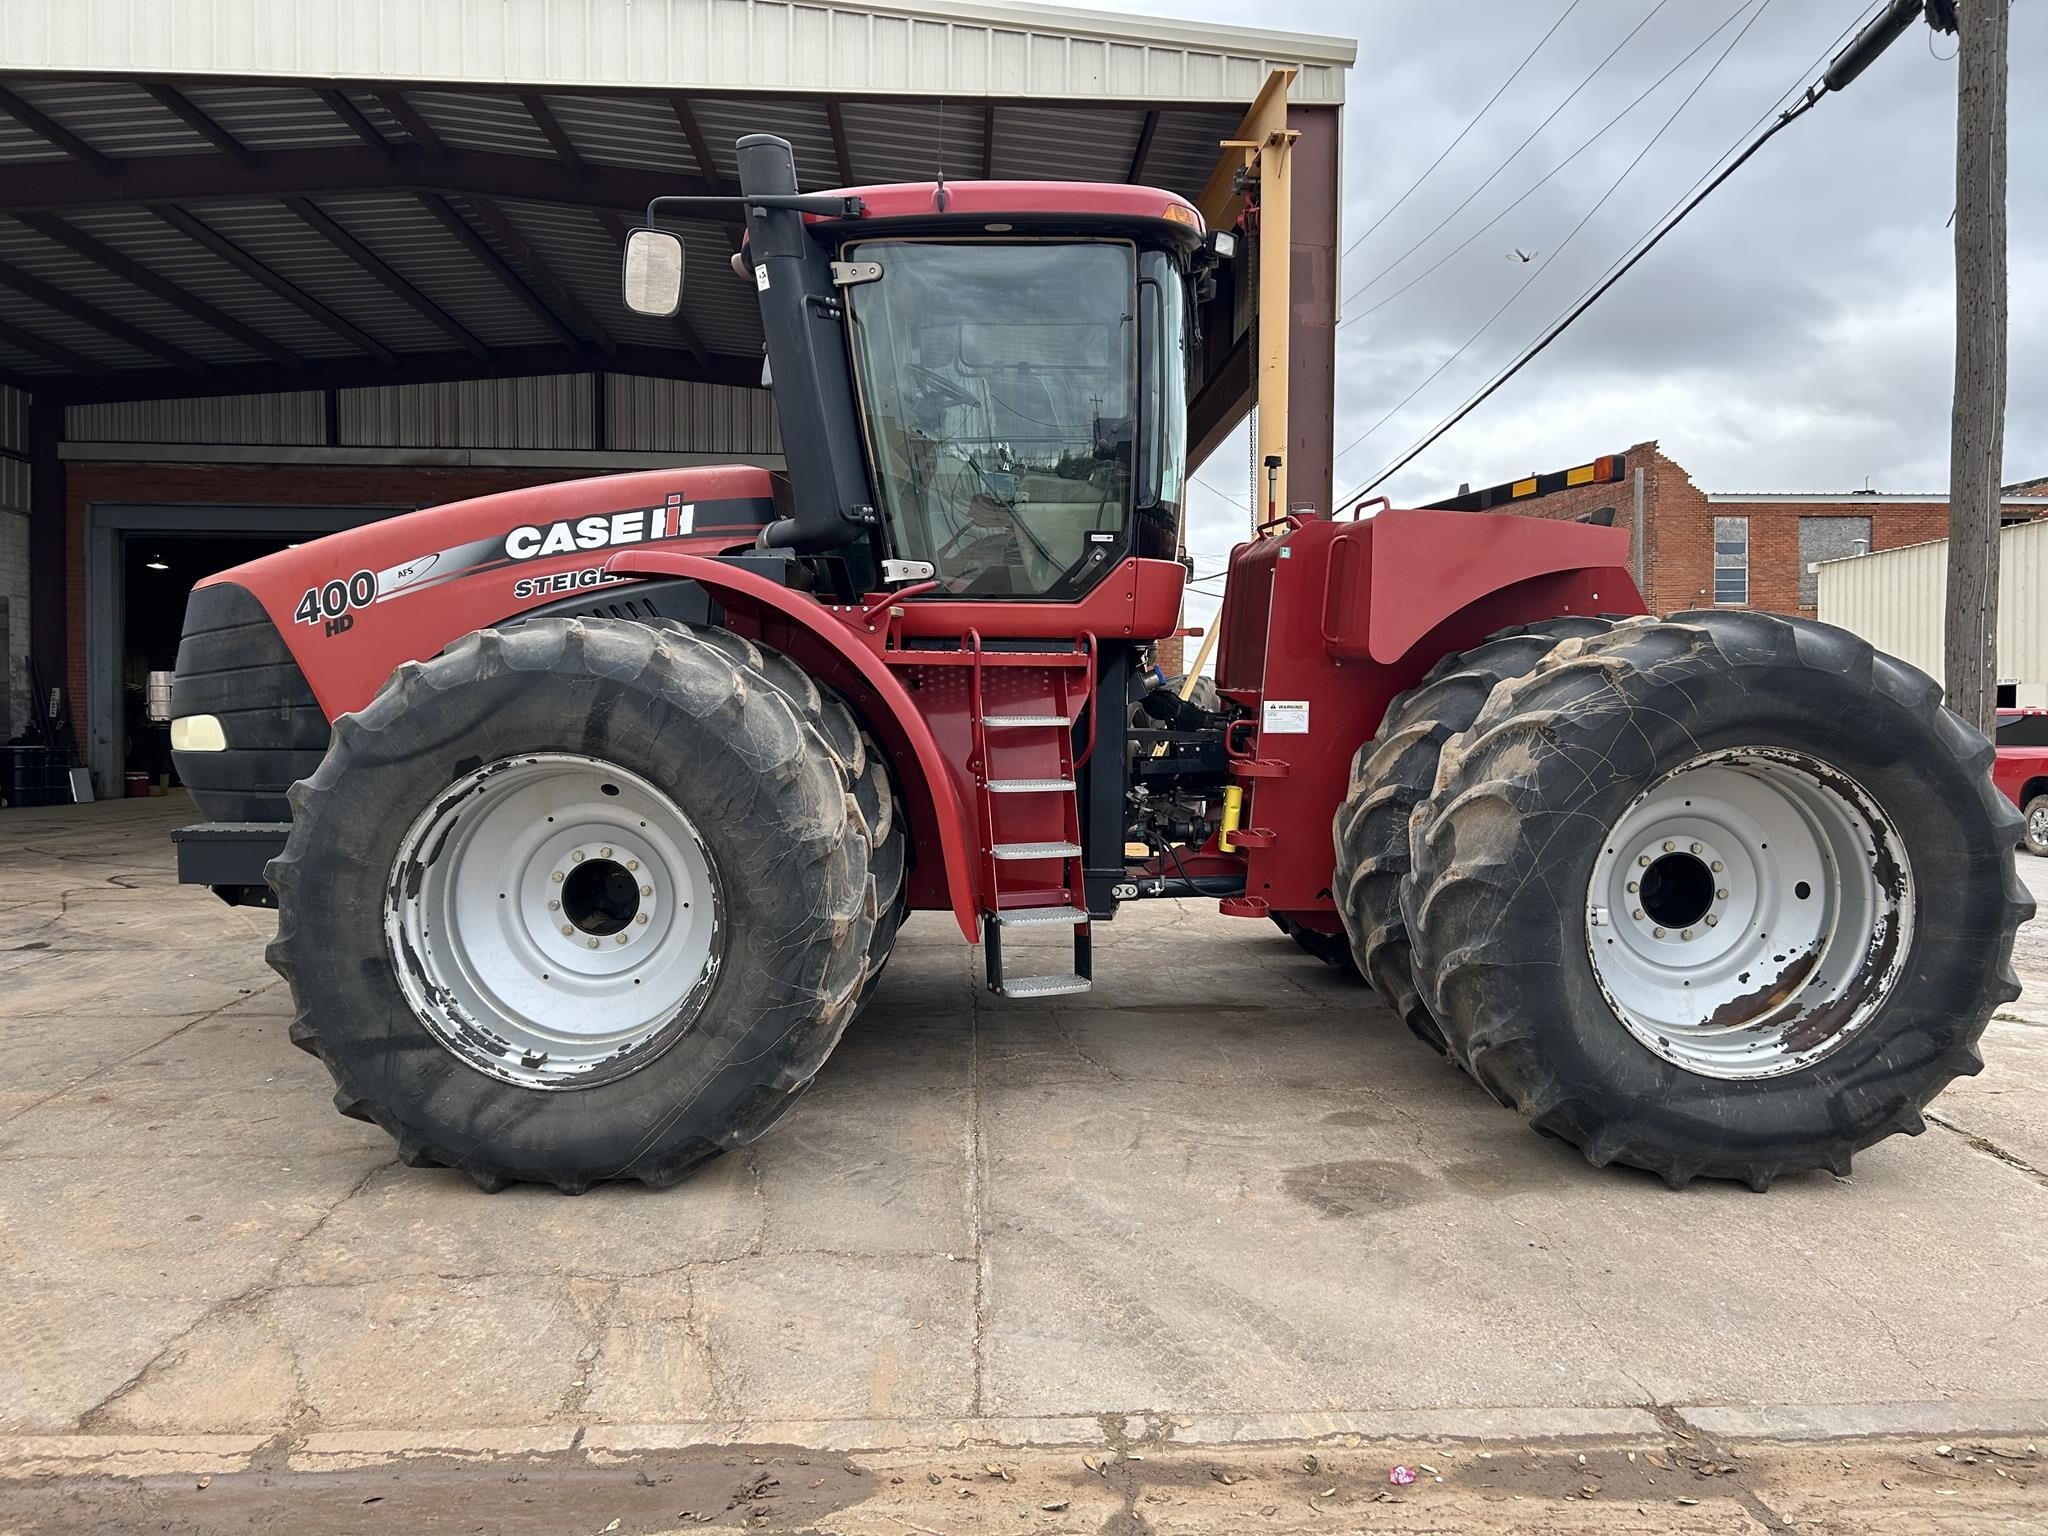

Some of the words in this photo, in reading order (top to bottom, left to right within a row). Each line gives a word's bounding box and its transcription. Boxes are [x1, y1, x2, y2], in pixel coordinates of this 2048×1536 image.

[505, 511, 644, 559] CASE
[397, 566, 414, 579] AFS
[294, 569, 378, 626] 400
[325, 614, 354, 638] HD
